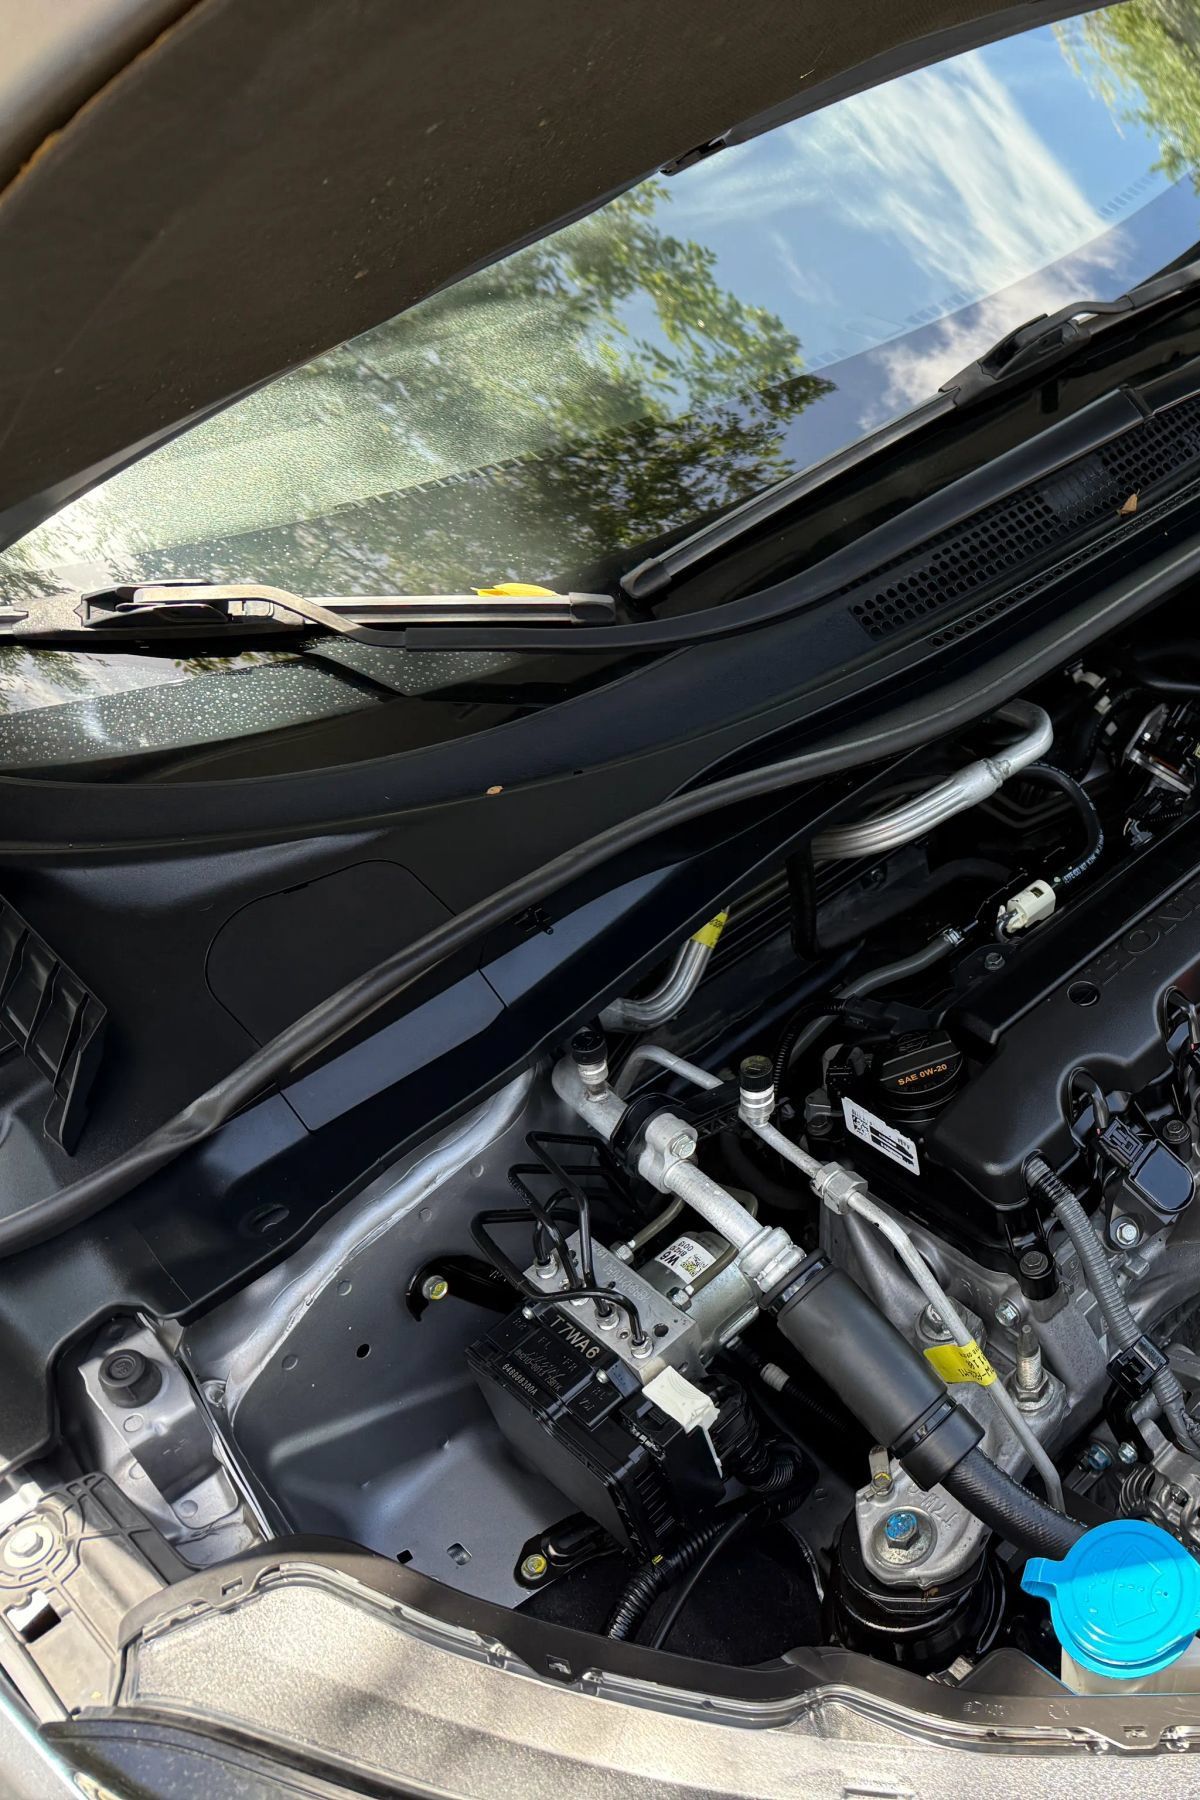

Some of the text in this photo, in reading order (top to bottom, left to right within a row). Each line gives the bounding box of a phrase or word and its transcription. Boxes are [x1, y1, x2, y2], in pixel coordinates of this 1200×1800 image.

[898, 1063, 948, 1086] SAE 0W-20
[660, 1251, 680, 1266] W6
[549, 1314, 600, 1359] T7WA6
